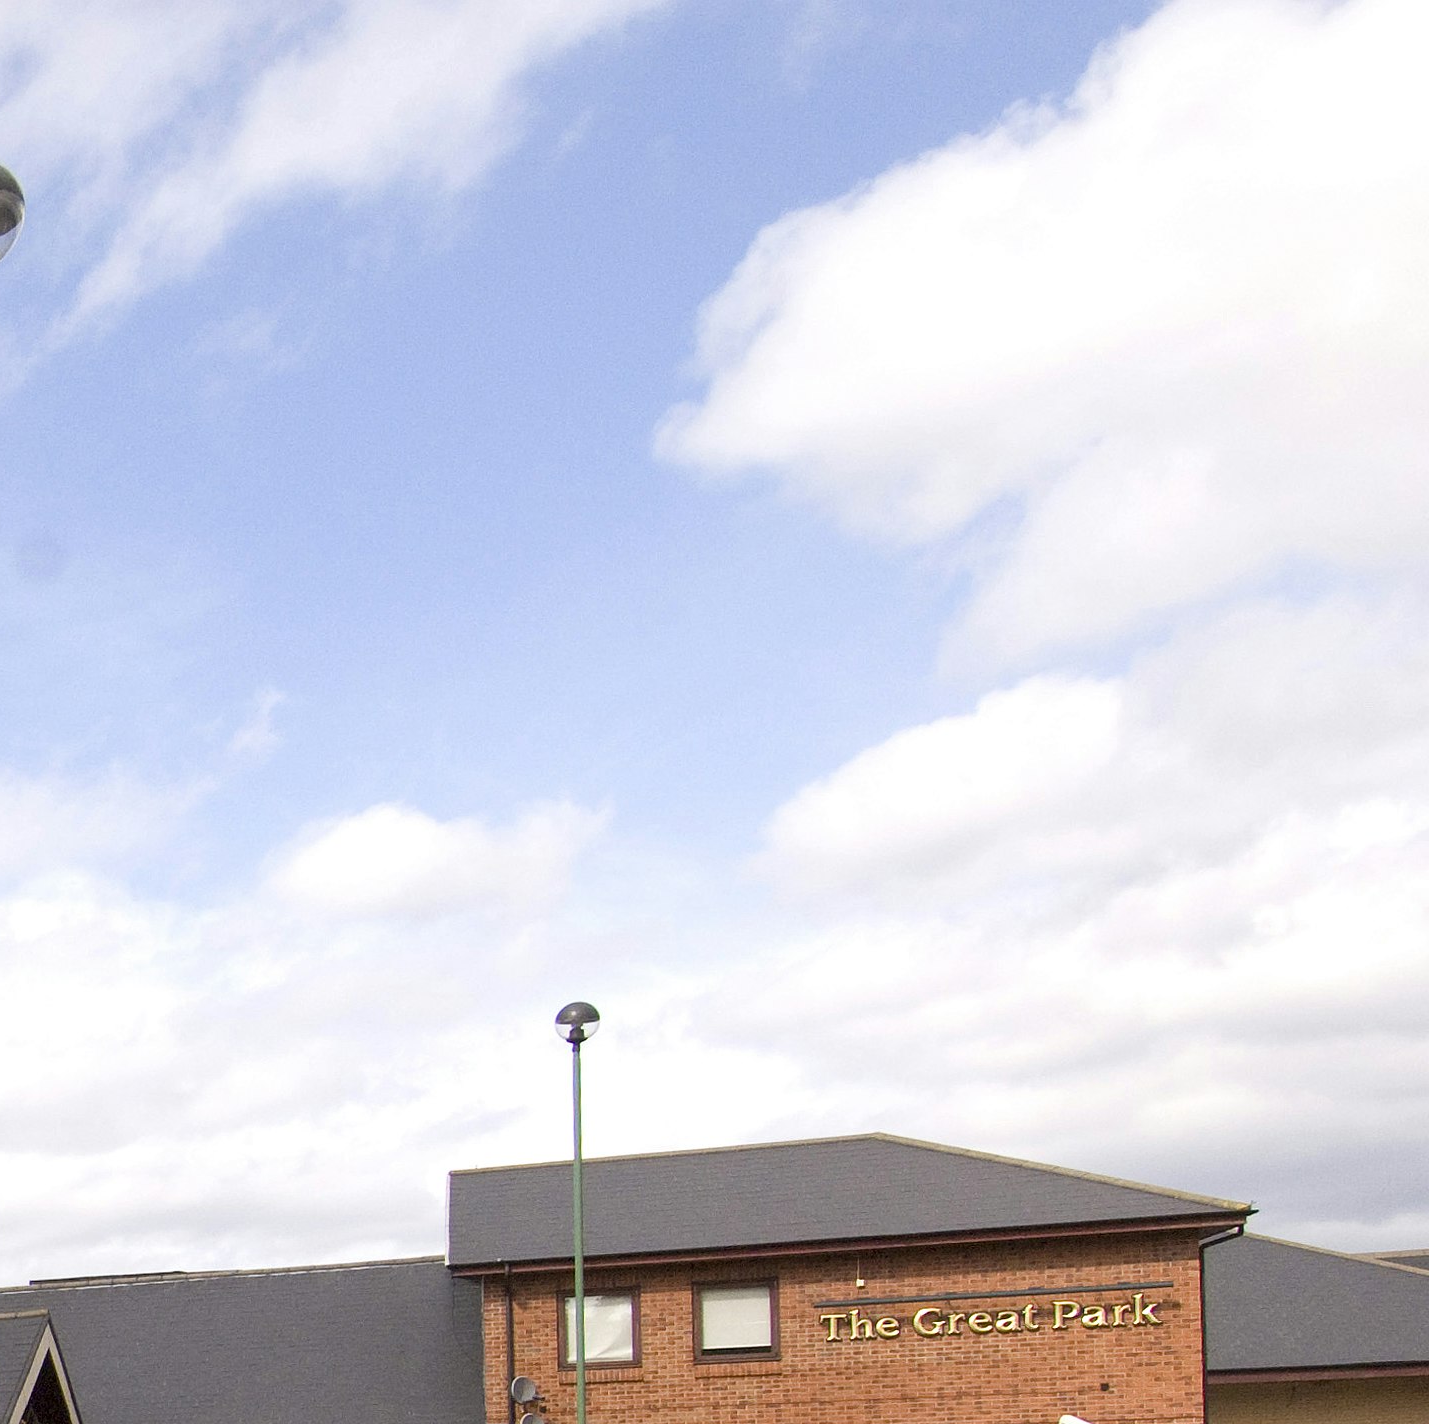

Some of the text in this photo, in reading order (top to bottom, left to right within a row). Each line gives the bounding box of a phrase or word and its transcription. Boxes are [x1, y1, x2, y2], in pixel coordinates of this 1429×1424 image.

[820, 1292, 1163, 1342] The Great Park
